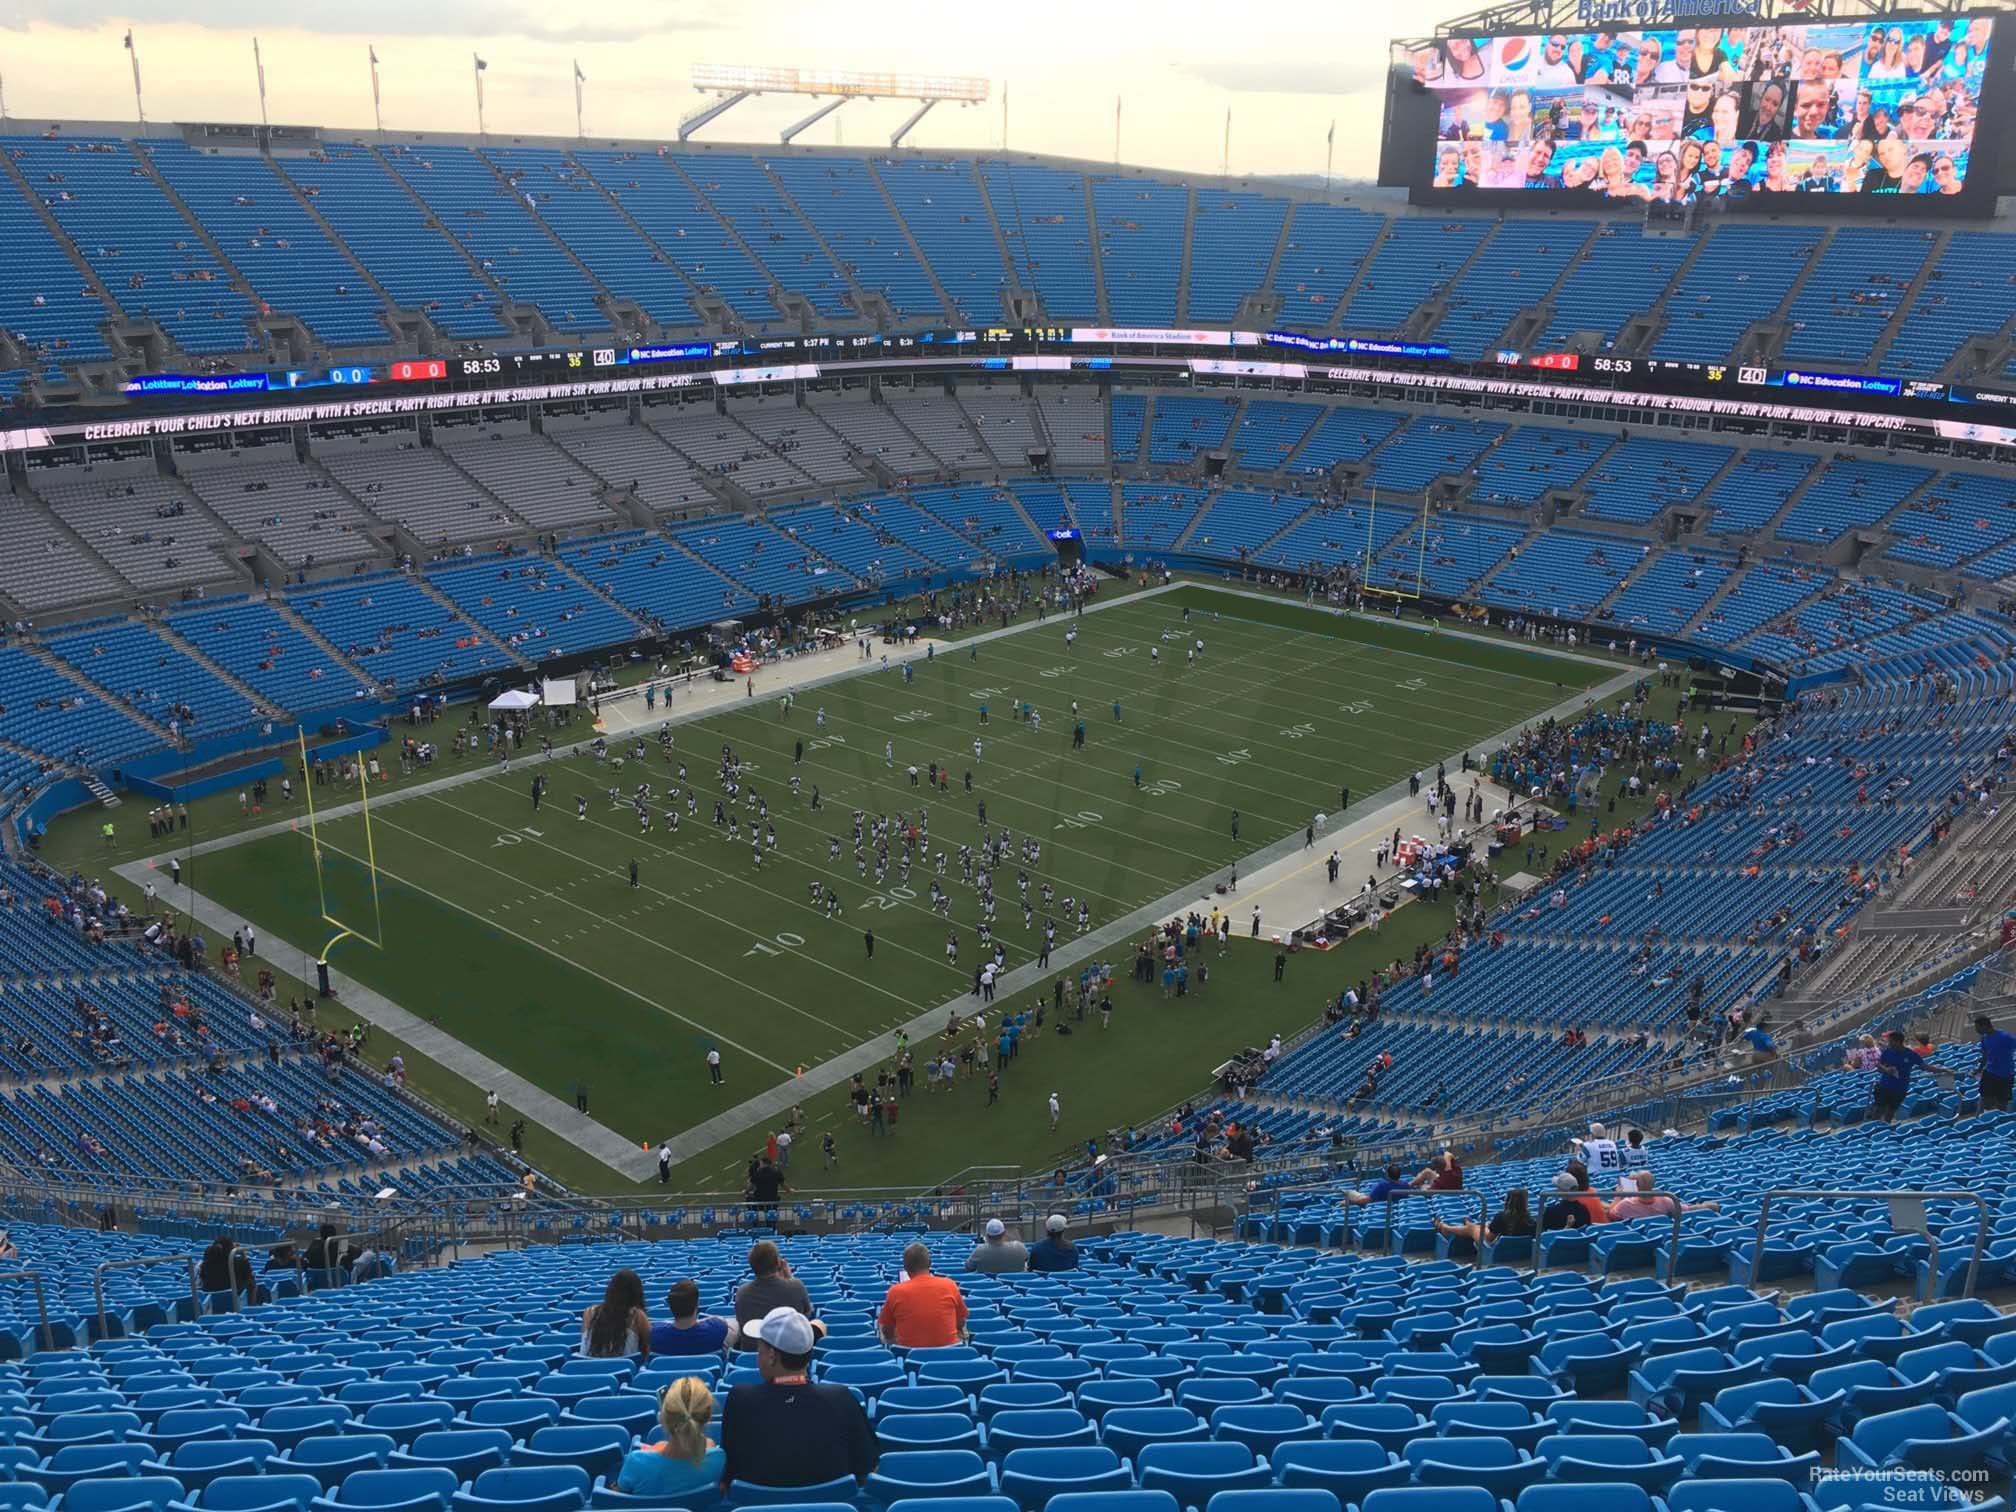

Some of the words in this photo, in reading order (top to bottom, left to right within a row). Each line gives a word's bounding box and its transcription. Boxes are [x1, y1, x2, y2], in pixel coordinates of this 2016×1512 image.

[1578, 0, 1634, 20] Bank
[1637, 0, 1657, 17] of
[1661, 0, 1761, 16] America
[1140, 332, 1164, 340] America
[640, 350, 652, 359] NC
[652, 349, 684, 358] Education
[685, 347, 708, 356] Lottery
[1358, 342, 1369, 351] NC
[1369, 344, 1402, 353] Education
[1403, 346, 1428, 356] Lottery
[568, 358, 582, 368] 35
[597, 352, 614, 364] 40
[1562, 356, 1571, 369] 0
[1594, 358, 1632, 373] 58:53
[401, 365, 411, 378] 0
[429, 363, 439, 377] 0
[463, 359, 501, 374] 58:53
[332, 370, 342, 383] 0
[352, 369, 361, 383] 0
[1707, 370, 1722, 380] 35
[1743, 370, 1762, 382] 40
[229, 379, 264, 389] Lottery
[1799, 375, 1814, 385] NC
[1815, 376, 1861, 389] Education
[1863, 380, 1897, 393] Lottery
[1327, 368, 1371, 381] CELEBRATE
[1371, 371, 1395, 384] YOUR
[1394, 375, 1425, 387] CHILD'S
[1425, 378, 1447, 389] NEXT
[1447, 378, 1488, 392] BIRTHDAY
[1487, 382, 1511, 394] WITH
[1517, 386, 1554, 398] SPECIAL
[1554, 388, 1584, 401] PARTY
[1583, 391, 1611, 404] RIGHT
[1611, 393, 1635, 406] HERE
[1636, 396, 1650, 406] AT
[1650, 398, 1670, 409] THE
[1669, 399, 1713, 413] STADIUM
[1713, 402, 1739, 415] WITH
[1739, 404, 1758, 417] SIR
[1759, 406, 1790, 419] PURR
[1790, 409, 1831, 423] AND/OR
[1832, 412, 1852, 425] THE
[84, 421, 151, 441] CELEBRATE
[154, 418, 185, 433] YOUR
[187, 413, 232, 430] CHILD'S
[233, 410, 260, 425] NEXT
[262, 406, 315, 424] BIRTHDAY
[315, 403, 344, 419] WITH
[343, 403, 351, 413] A
[352, 399, 394, 417] SPECIAL
[395, 397, 427, 412] PARTY
[427, 394, 456, 409] RIGHT
[456, 392, 480, 406] HERE
[482, 392, 495, 404] AT
[494, 390, 512, 403] THE
[511, 386, 550, 401] STADIUM
[549, 384, 572, 397] WITH
[572, 383, 587, 396] SIR
[588, 381, 611, 395] PURR
[611, 379, 641, 393] AND/OR
[641, 377, 656, 389] THE
[1338, 701, 1375, 714] 20
[1279, 724, 1316, 738] 30
[1215, 750, 1252, 765] 40
[1139, 779, 1183, 796] 50
[1063, 811, 1104, 829] 40
[498, 827, 545, 845] 10
[865, 887, 918, 911] 20
[753, 932, 806, 958] 10
[1600, 1151, 1617, 1168] 59
